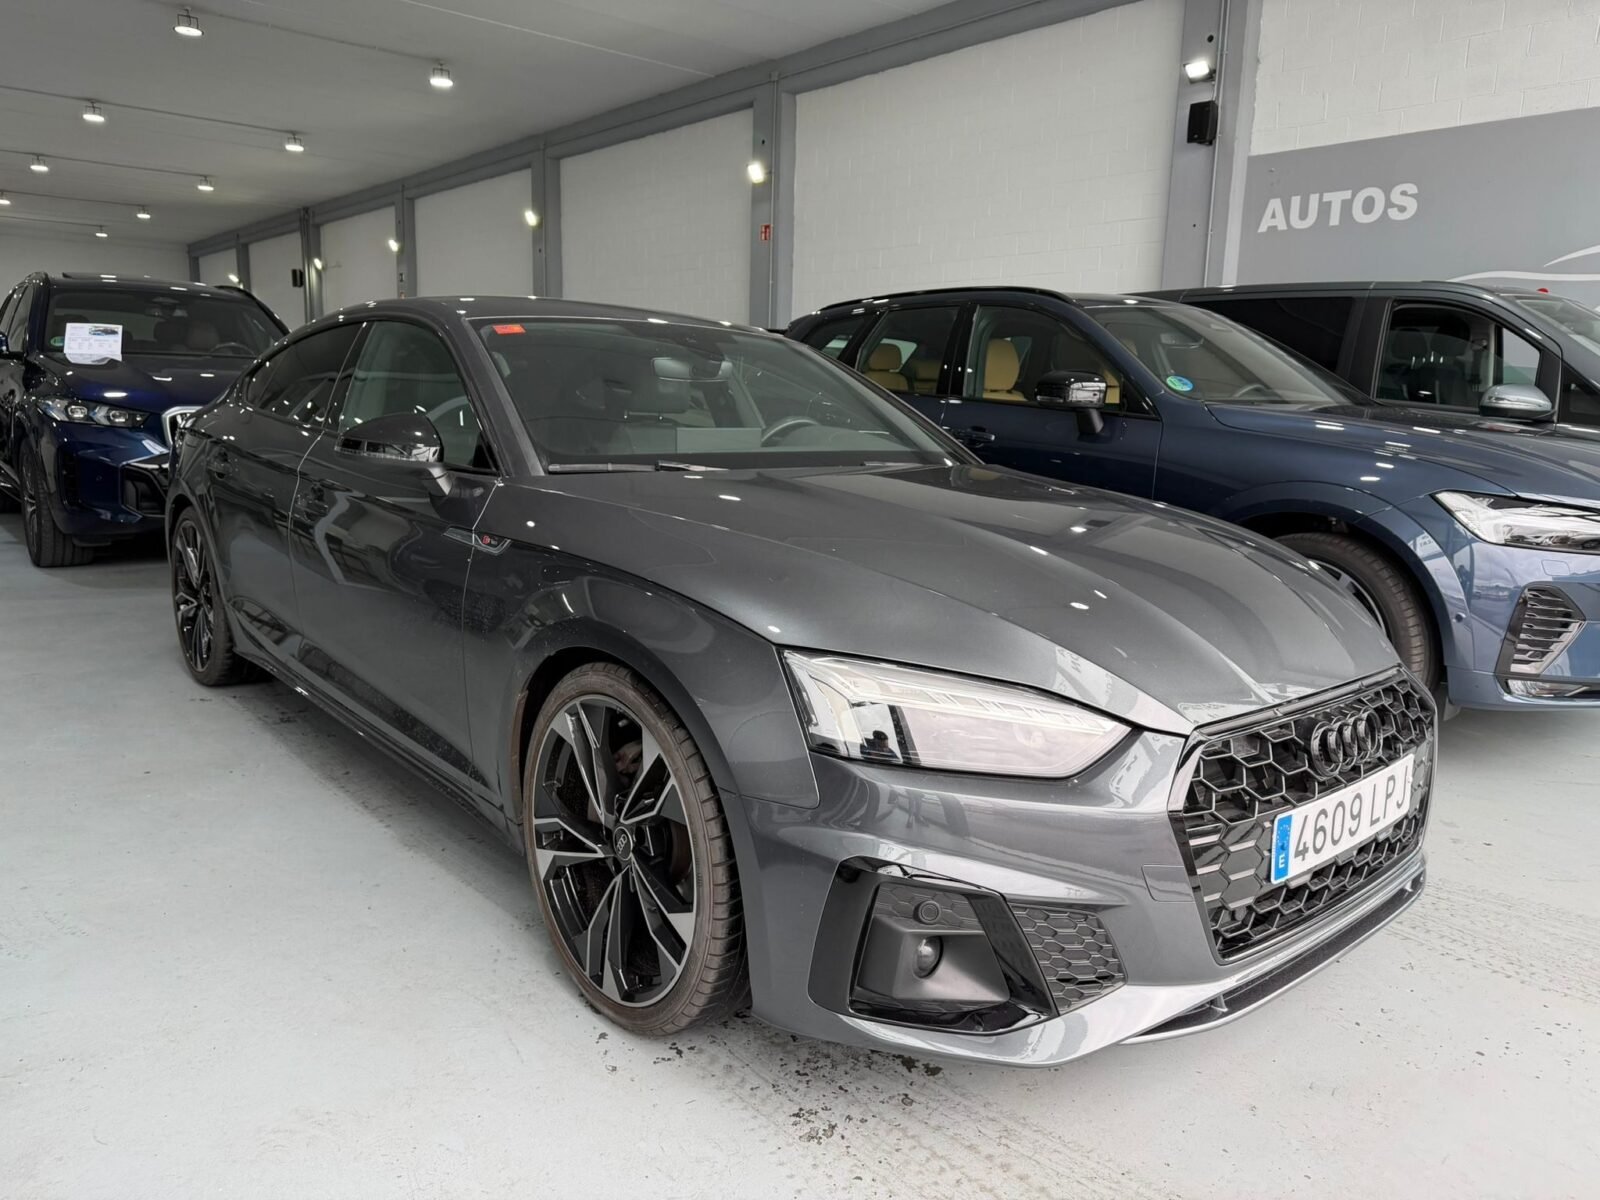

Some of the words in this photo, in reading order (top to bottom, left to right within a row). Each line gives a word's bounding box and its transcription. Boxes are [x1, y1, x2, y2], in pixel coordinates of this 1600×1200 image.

[1257, 183, 1418, 233] AUTOS
[1294, 792, 1362, 861] 4609
[1370, 765, 1408, 828] LPJ
[1278, 854, 1286, 868] E
